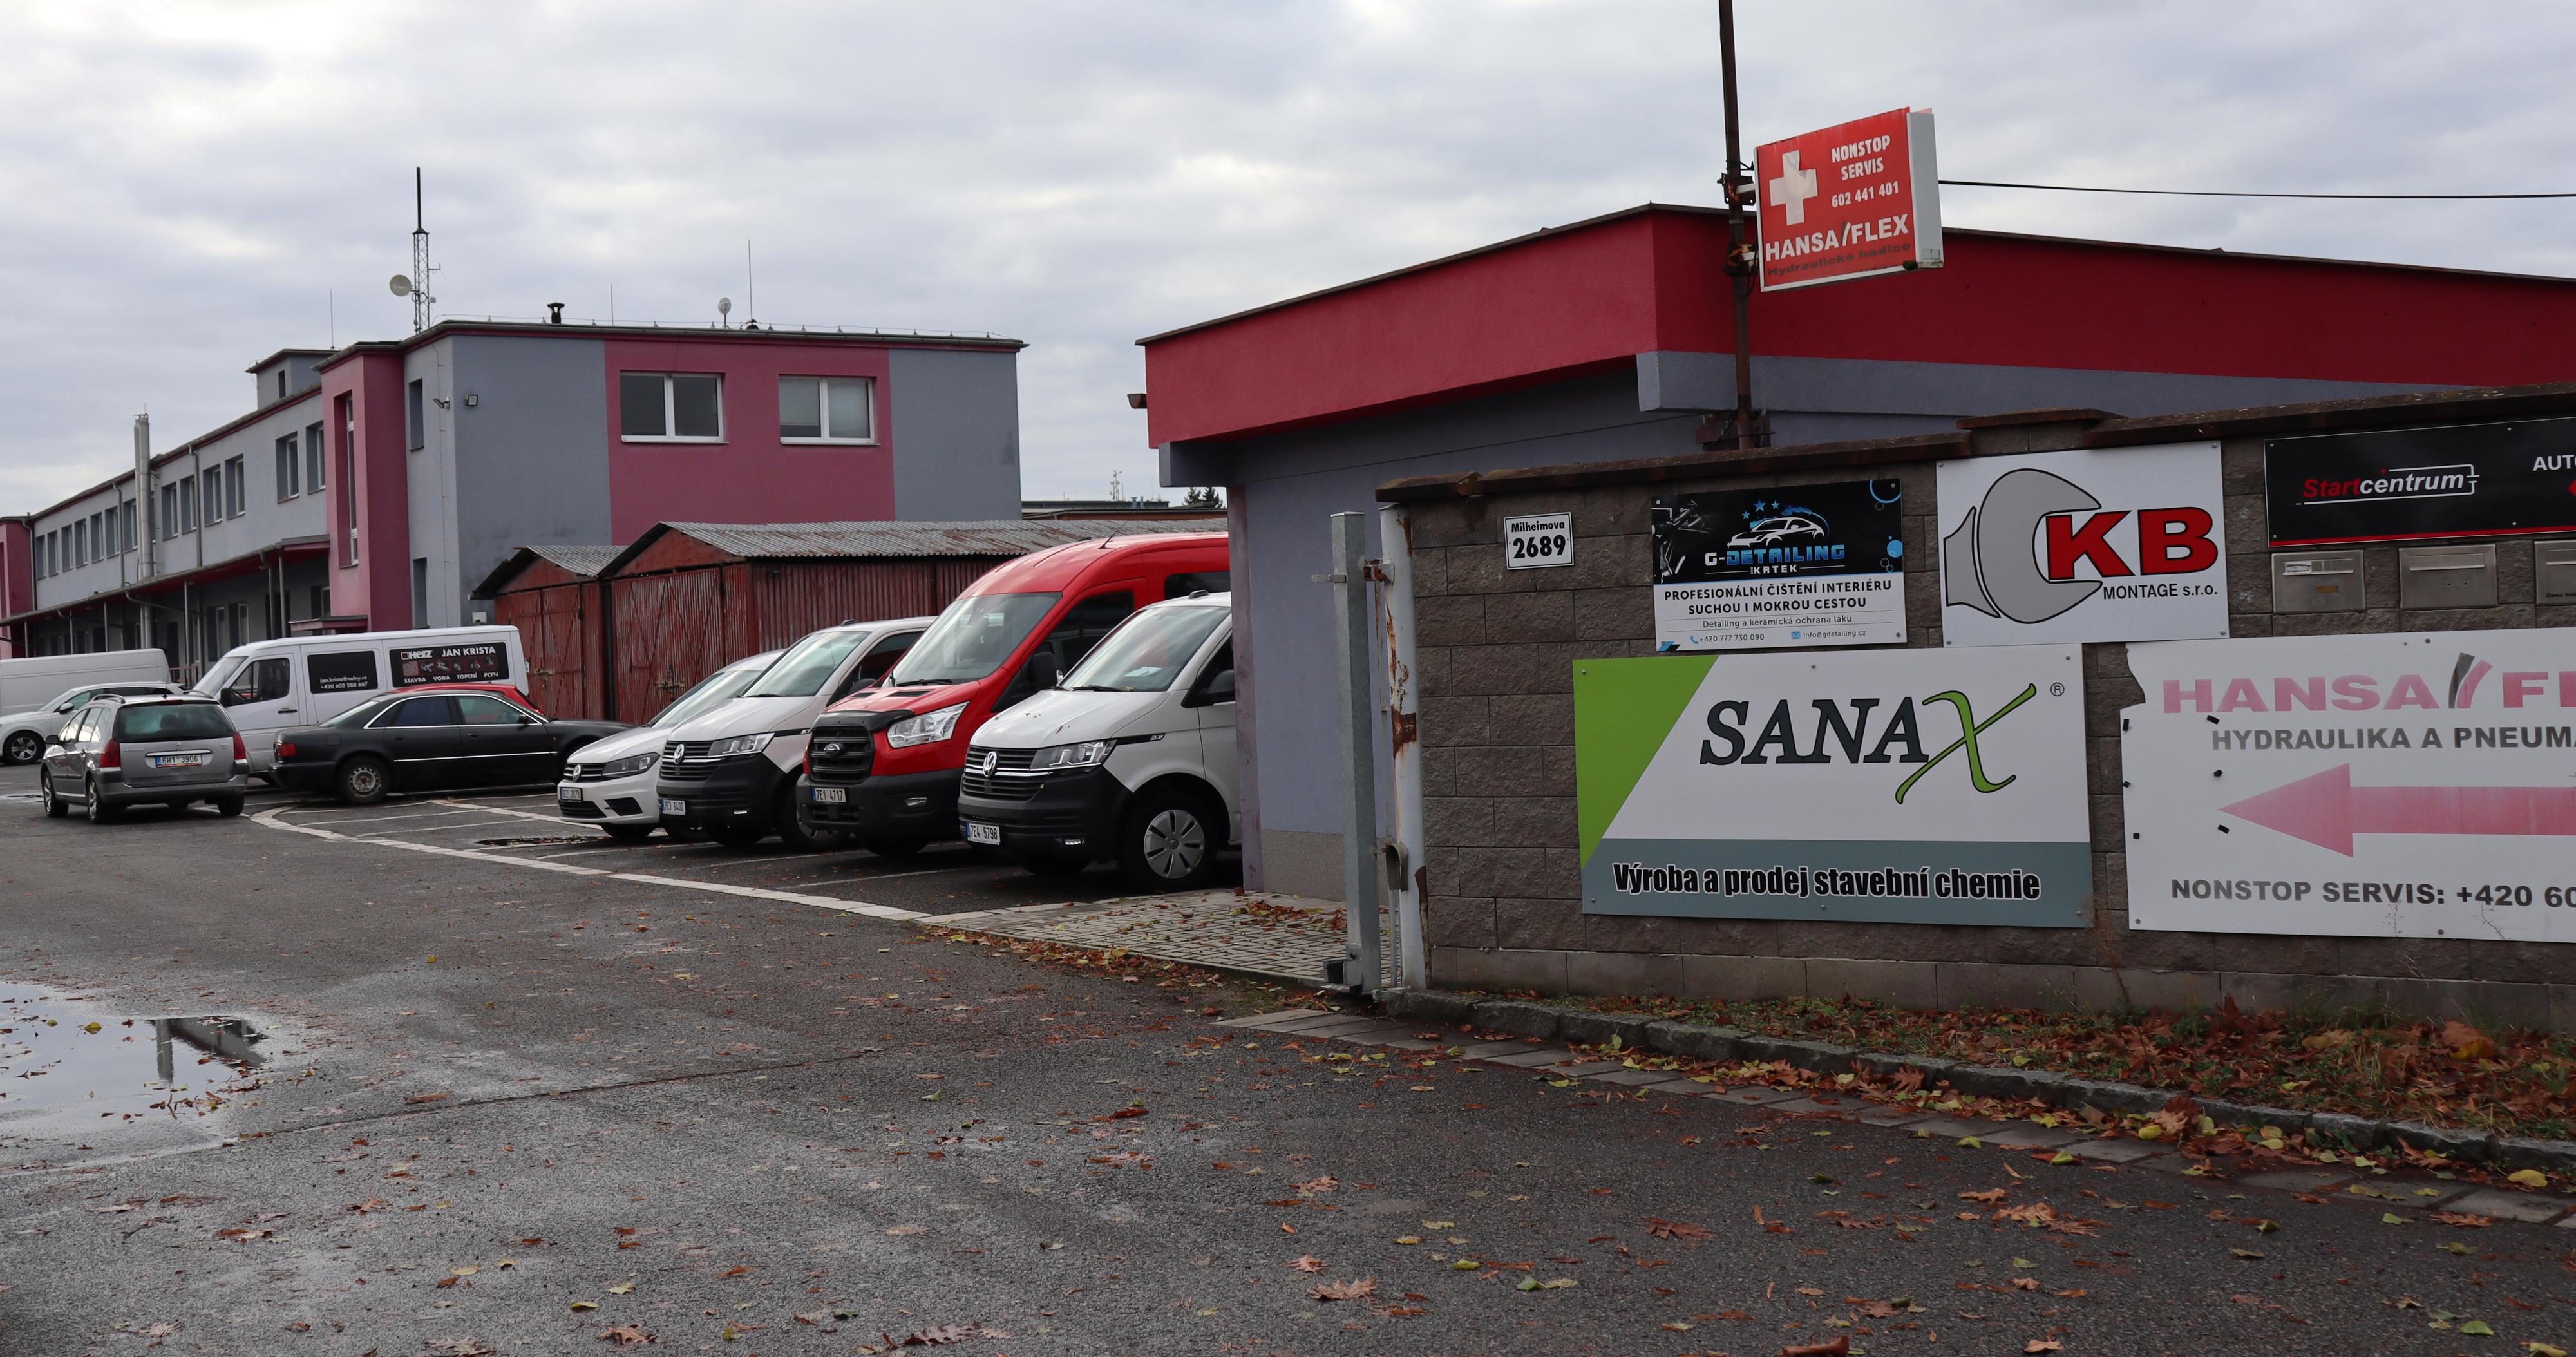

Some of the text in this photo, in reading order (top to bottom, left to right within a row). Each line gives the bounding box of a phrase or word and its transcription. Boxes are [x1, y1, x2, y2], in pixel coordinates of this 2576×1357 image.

[1831, 135, 1891, 163] NONSTOP
[1841, 157, 1884, 181] SERVIS
[1832, 180, 1899, 207] 602 441 401
[1768, 243, 1911, 276] Hydraulické hadice
[2532, 454, 2576, 471] AUT
[2303, 473, 2465, 498] Startcentrum
[1511, 520, 1565, 533] Milheimova
[1513, 535, 1566, 559] 2689
[2045, 506, 2219, 581] KB
[1705, 544, 1845, 567] G-DETAILING
[1665, 578, 1891, 601] PROFESIONÁLNÍ ČIŠTĚNÍ INTERIÉRU
[2103, 583, 2219, 600] MONTAGE s.r.o.
[1689, 598, 1866, 615] SUCHOU I MOKROU CESTOU
[1703, 620, 1740, 629] Detailing
[1750, 616, 1793, 626] keramická
[1795, 616, 1832, 625] ochrana
[1834, 614, 1852, 623] laku
[1803, 630, 1866, 639] info@gdetailing.cz
[442, 648, 461, 658] JAN
[463, 646, 497, 656] KRISTA
[457, 672, 478, 680] TOPENÍ
[1700, 683, 2037, 805] SANAX
[2212, 726, 2576, 750] HYDRAULIKA A PNEUM
[162, 755, 198, 764] 6H1 3906
[816, 789, 842, 801] 7E1 4717
[970, 824, 998, 840] 7E4 5798
[1612, 862, 2041, 900] Výroba a prodej stavební chemie
[2171, 878, 2312, 902] NONSTOP
[2322, 881, 2445, 906] SERVIS:
[2456, 885, 2533, 907] +420
